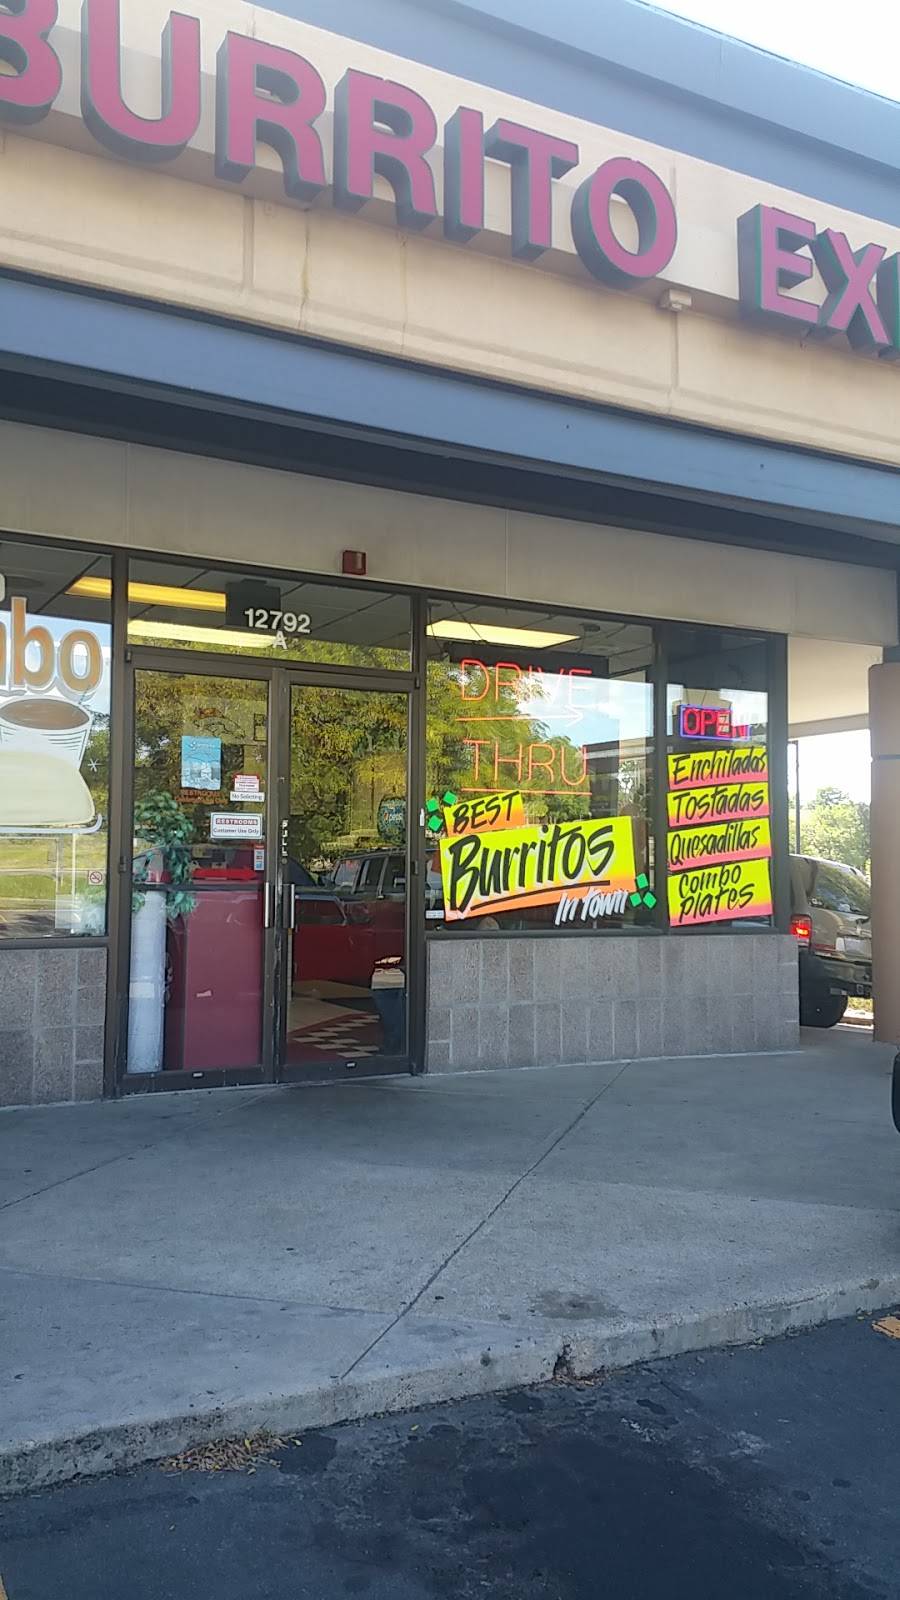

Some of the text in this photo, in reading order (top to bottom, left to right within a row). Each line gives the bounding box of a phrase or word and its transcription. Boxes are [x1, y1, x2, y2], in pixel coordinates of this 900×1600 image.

[738, 203, 900, 356] EX
[244, 608, 311, 634] 12792
[272, 631, 288, 650] A
[461, 659, 592, 708] DRIVE
[683, 707, 748, 738] OPEN
[463, 737, 588, 786] THRU
[672, 745, 767, 785] Enchiladas
[215, 818, 258, 826] RESTROOMS
[452, 790, 520, 834] BEST
[673, 784, 764, 824] Tostadas
[213, 826, 237, 834] Customer
[247, 827, 259, 835] Only
[670, 823, 760, 866] Quesadillas
[448, 824, 615, 915] Burritos
